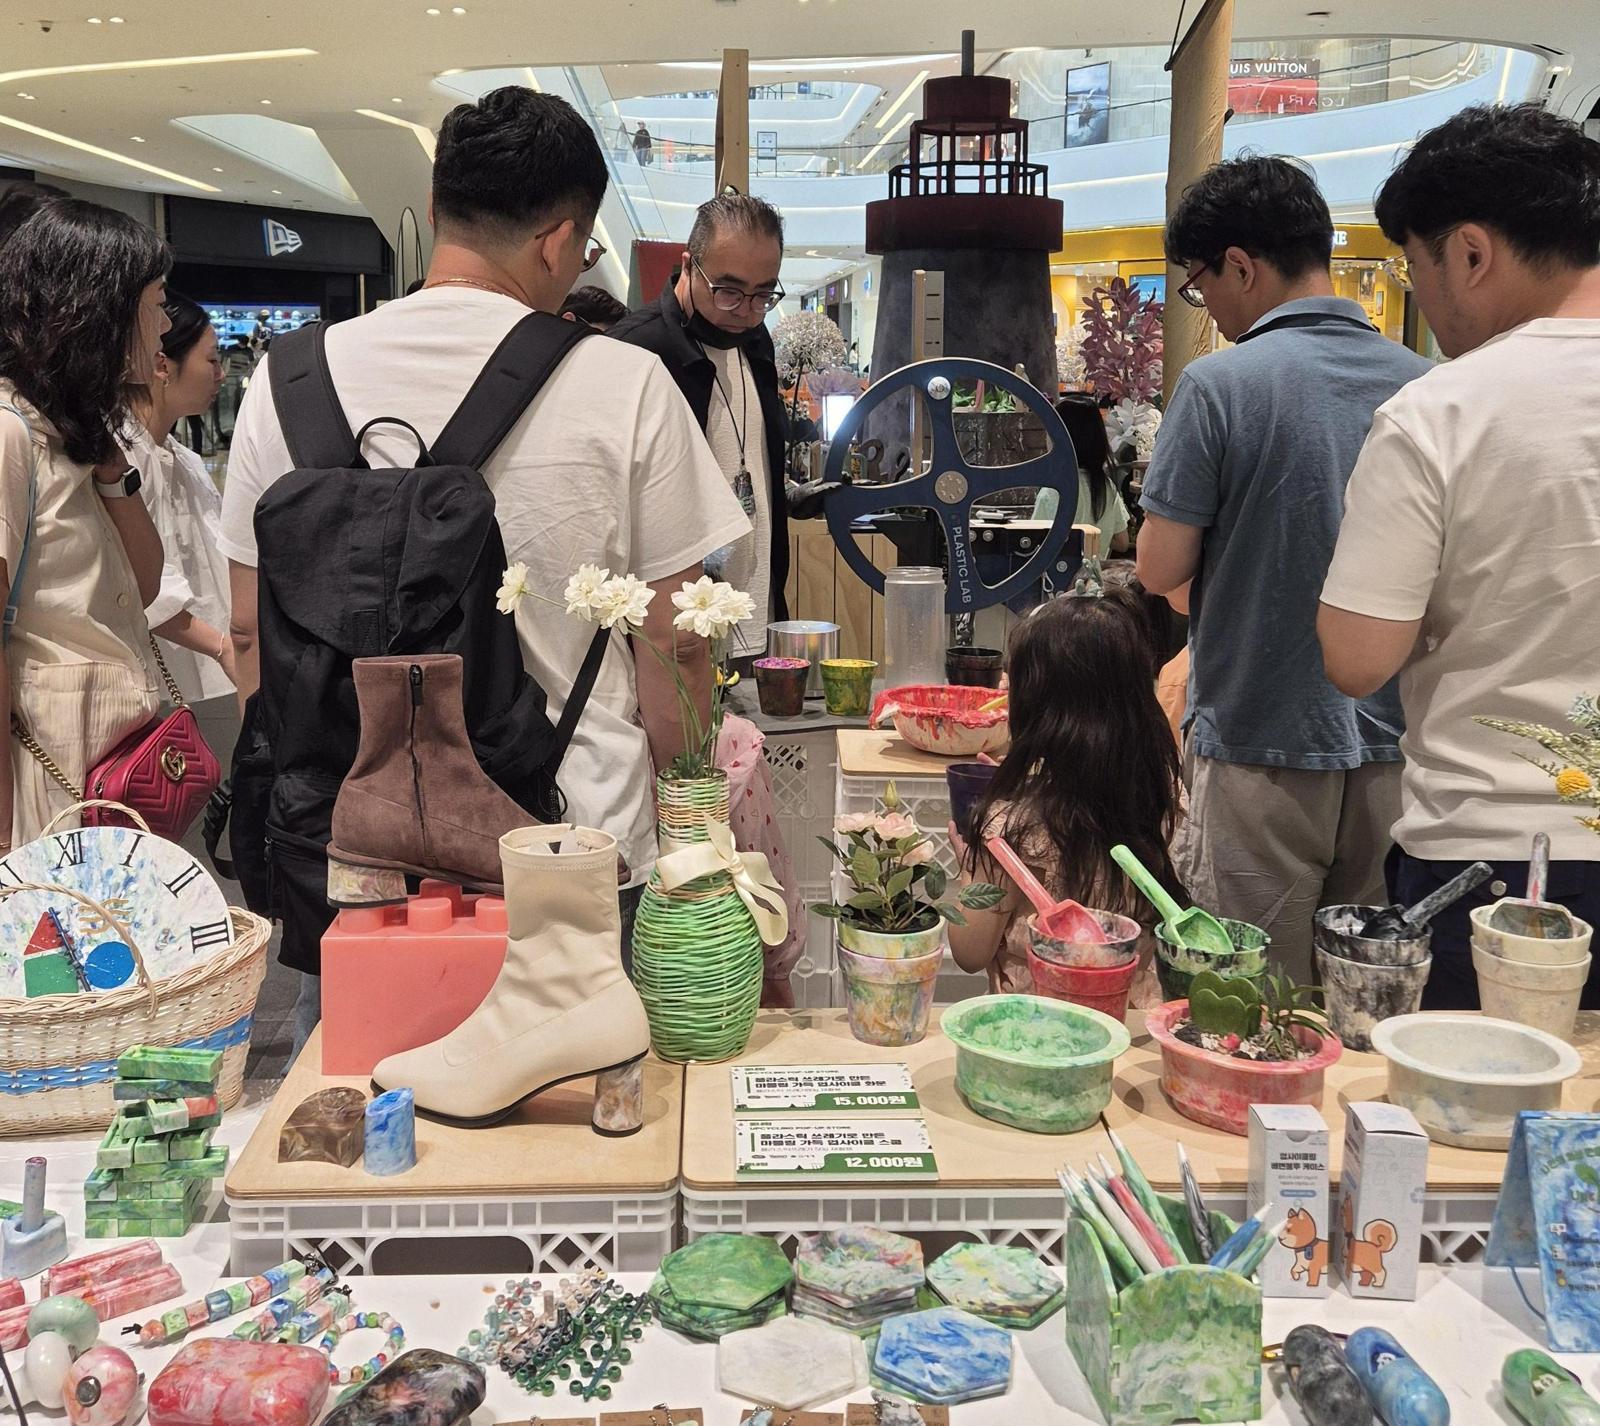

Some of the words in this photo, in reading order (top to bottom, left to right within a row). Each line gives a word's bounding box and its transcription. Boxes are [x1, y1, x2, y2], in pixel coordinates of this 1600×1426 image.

[1255, 63, 1308, 74] VUITTON
[952, 526, 969, 578] PLASTIC
[960, 580, 972, 603] LAB
[53, 831, 88, 869] XII
[163, 861, 204, 899] II
[189, 917, 230, 954] III
[833, 1095, 907, 1106] 15,000원
[844, 1156, 923, 1168] 12,000원
[1303, 1162, 1326, 1171] 케이스
